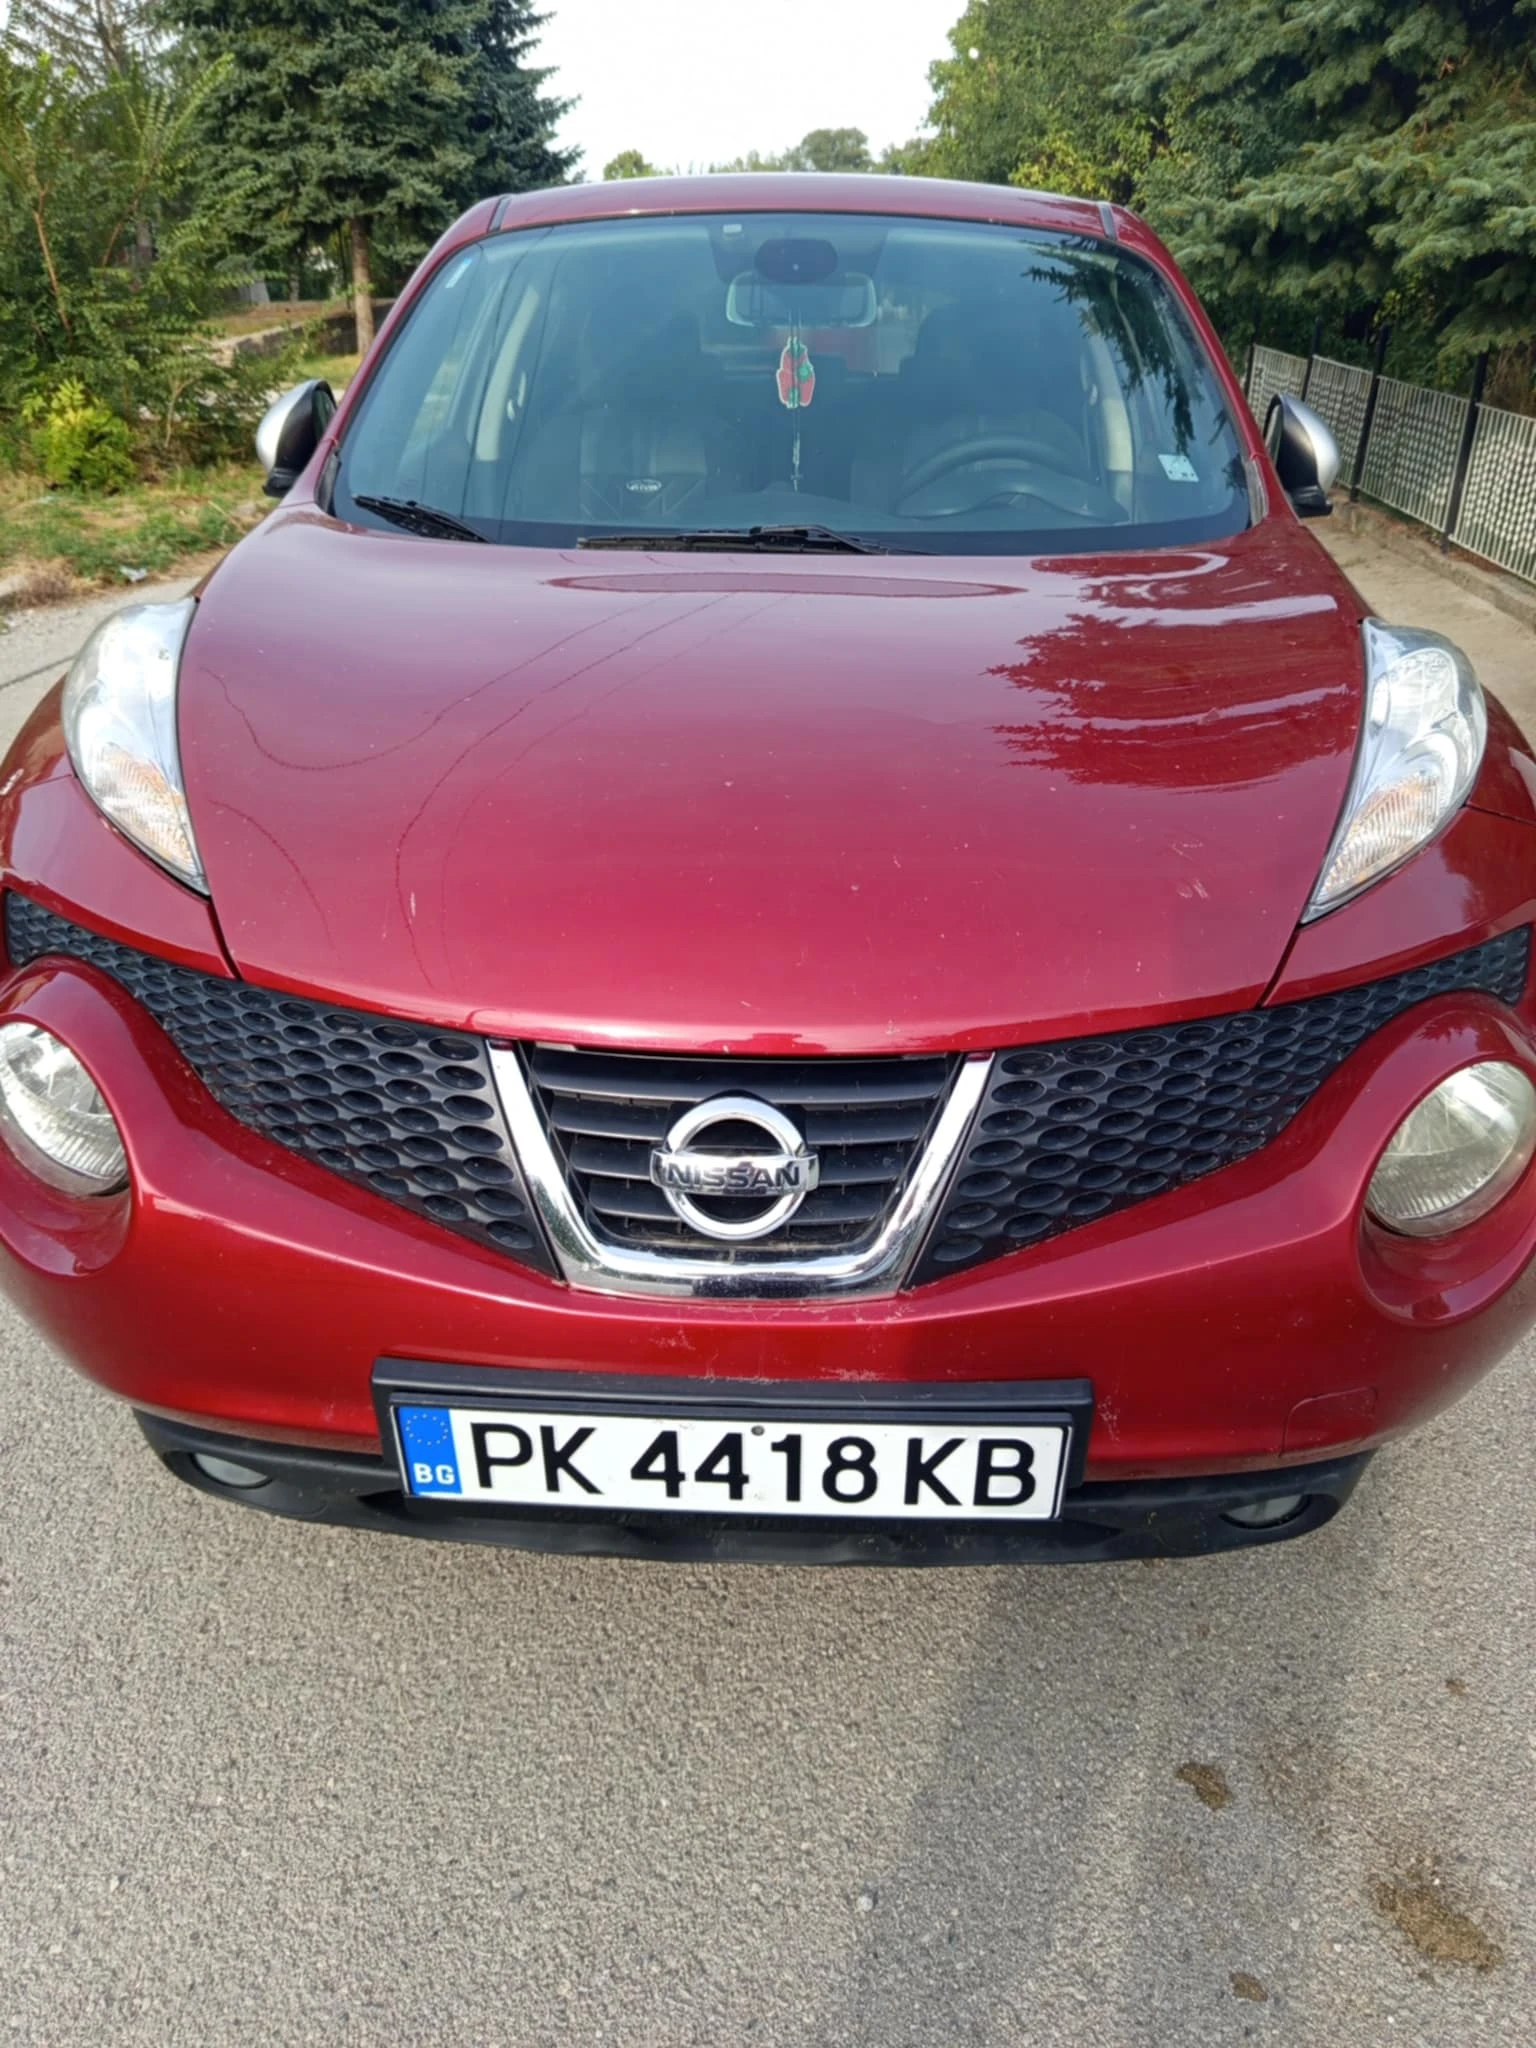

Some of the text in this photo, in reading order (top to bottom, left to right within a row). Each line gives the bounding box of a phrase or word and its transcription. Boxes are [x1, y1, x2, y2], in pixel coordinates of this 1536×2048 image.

[666, 1162, 800, 1188] NISSAN
[413, 1461, 455, 1486] BG
[469, 1421, 1038, 1508] PK 4418 KB
